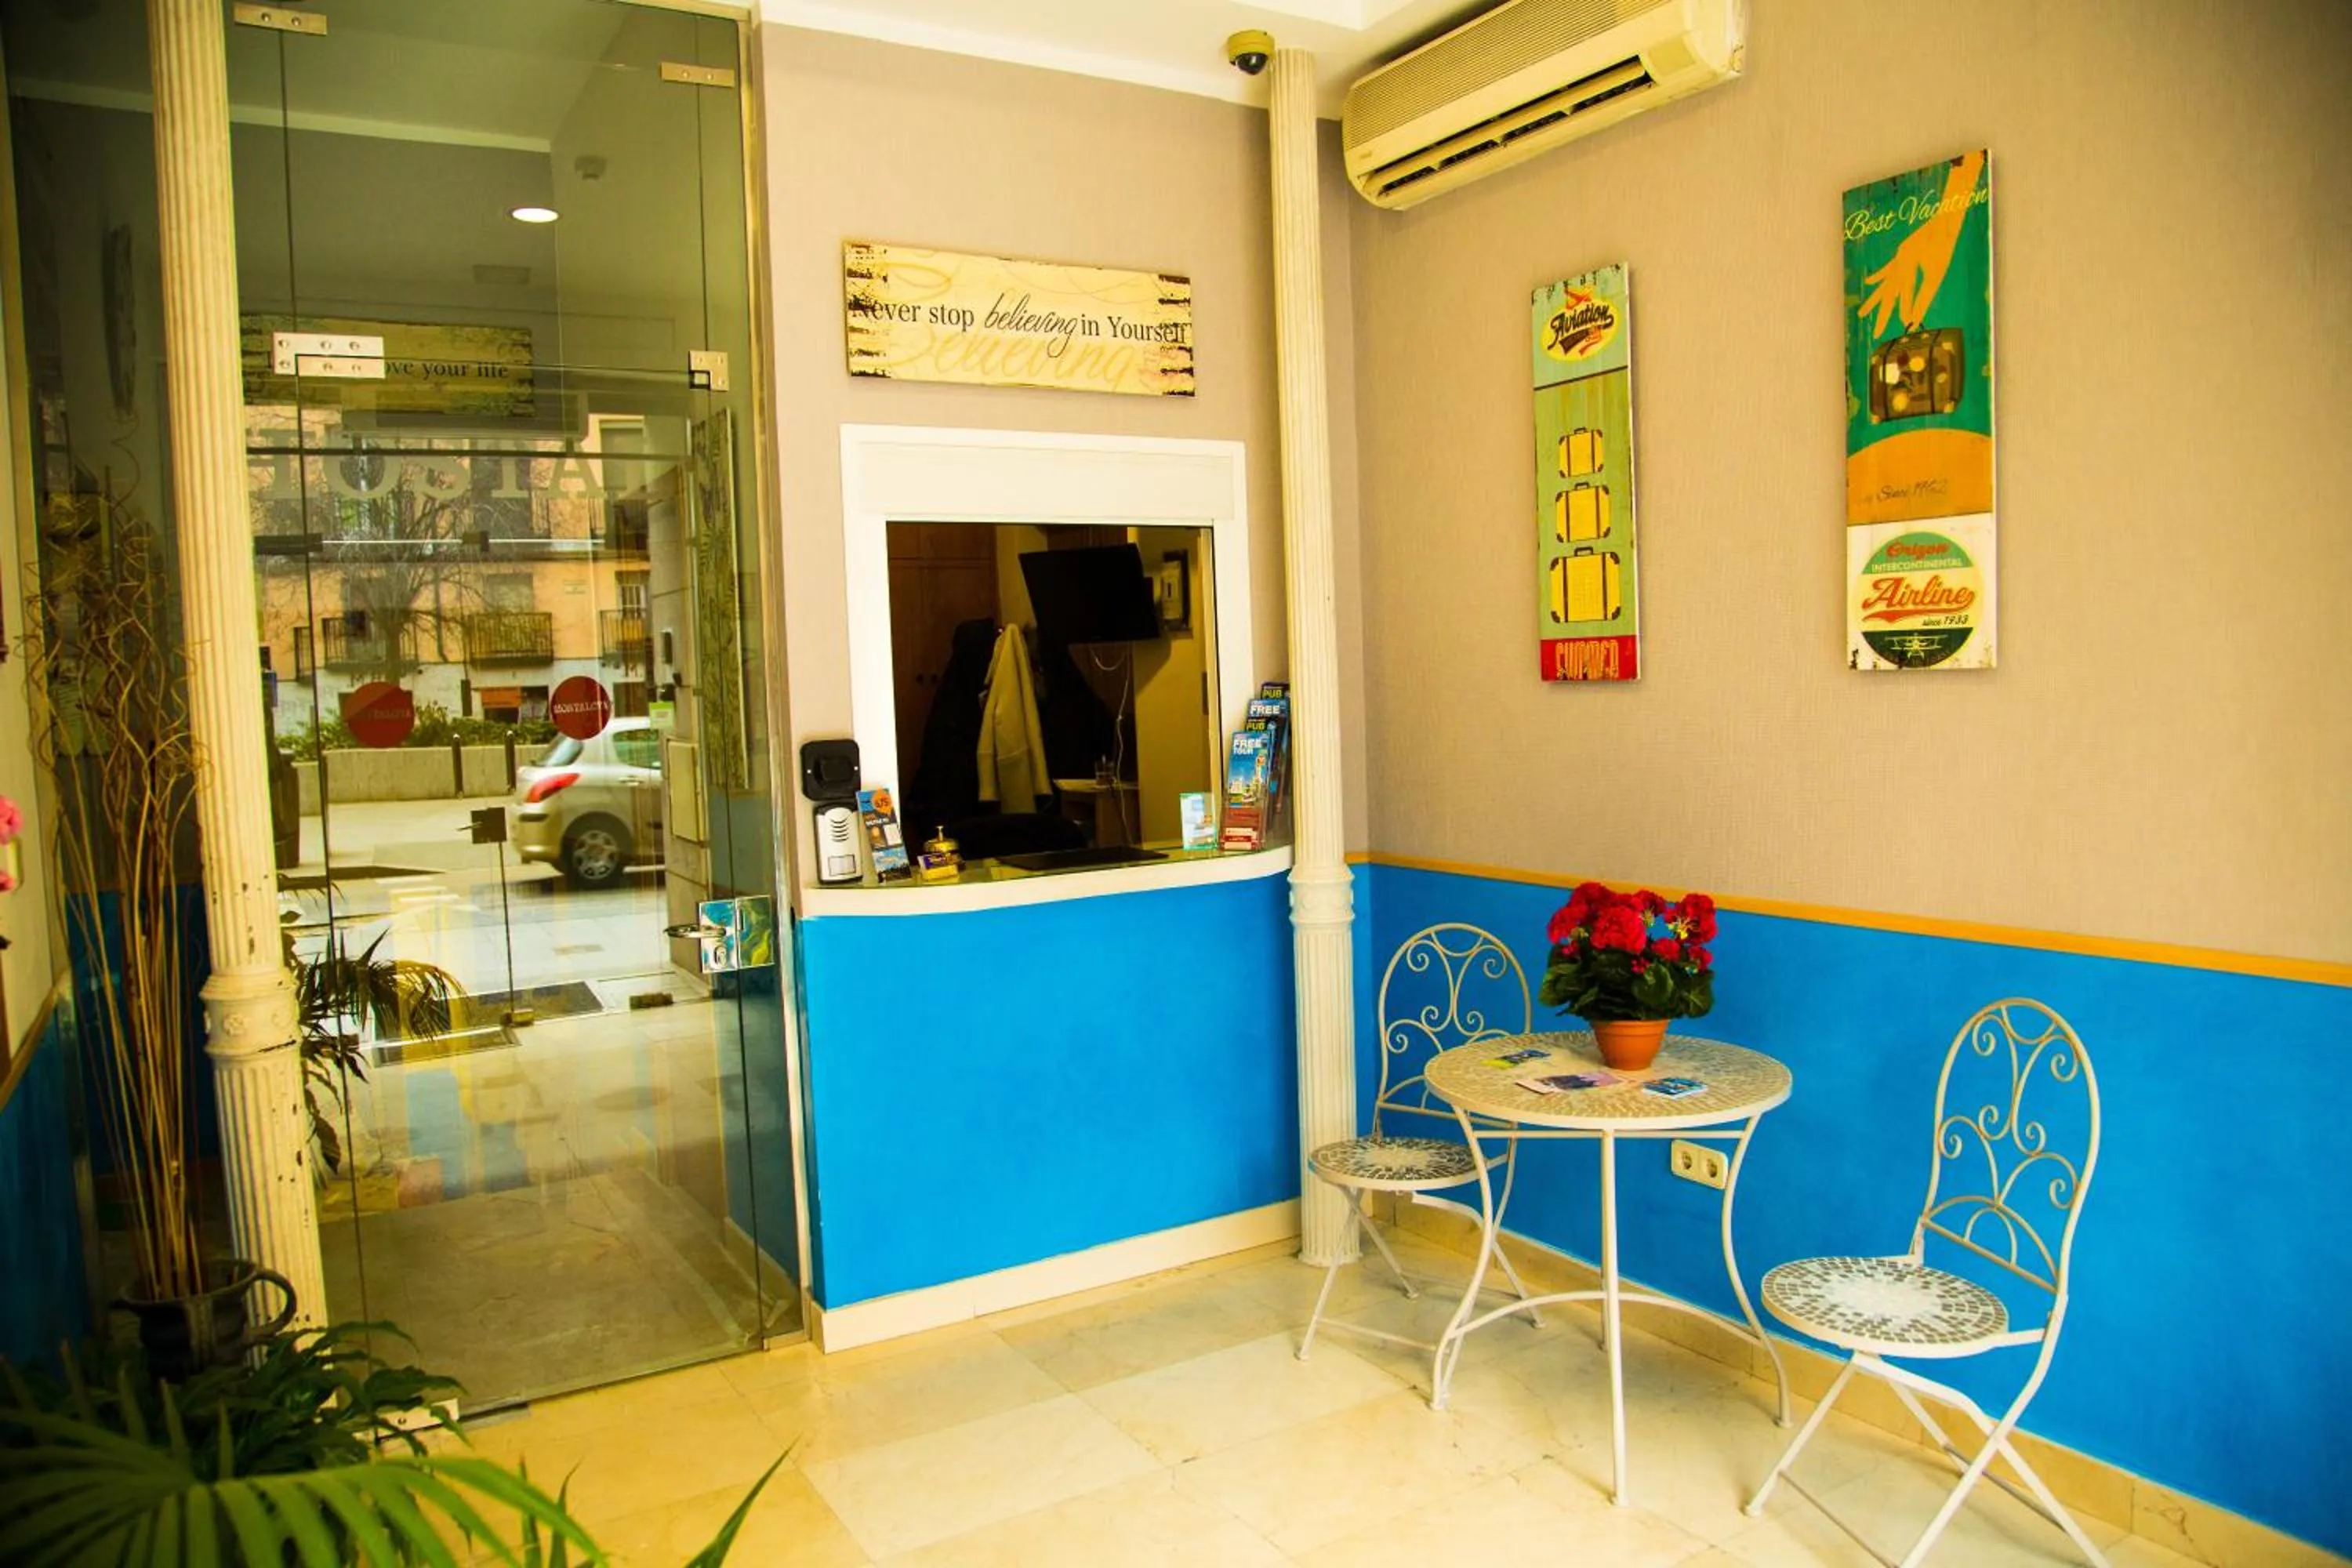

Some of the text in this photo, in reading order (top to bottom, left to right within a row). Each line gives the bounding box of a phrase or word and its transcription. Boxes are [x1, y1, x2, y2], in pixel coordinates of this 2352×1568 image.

[1844, 189, 1988, 240] Best Vacation
[928, 305, 975, 330] stop
[984, 292, 1078, 358] believing
[1081, 314, 1101, 337] in
[1107, 316, 1186, 343] Yourself
[1547, 303, 1614, 350] Aviation
[422, 361, 468, 380] your
[1871, 557, 1962, 573] INTERCONTINENTAL
[1862, 575, 1976, 610] Airline
[1250, 705, 1280, 714] FREE
